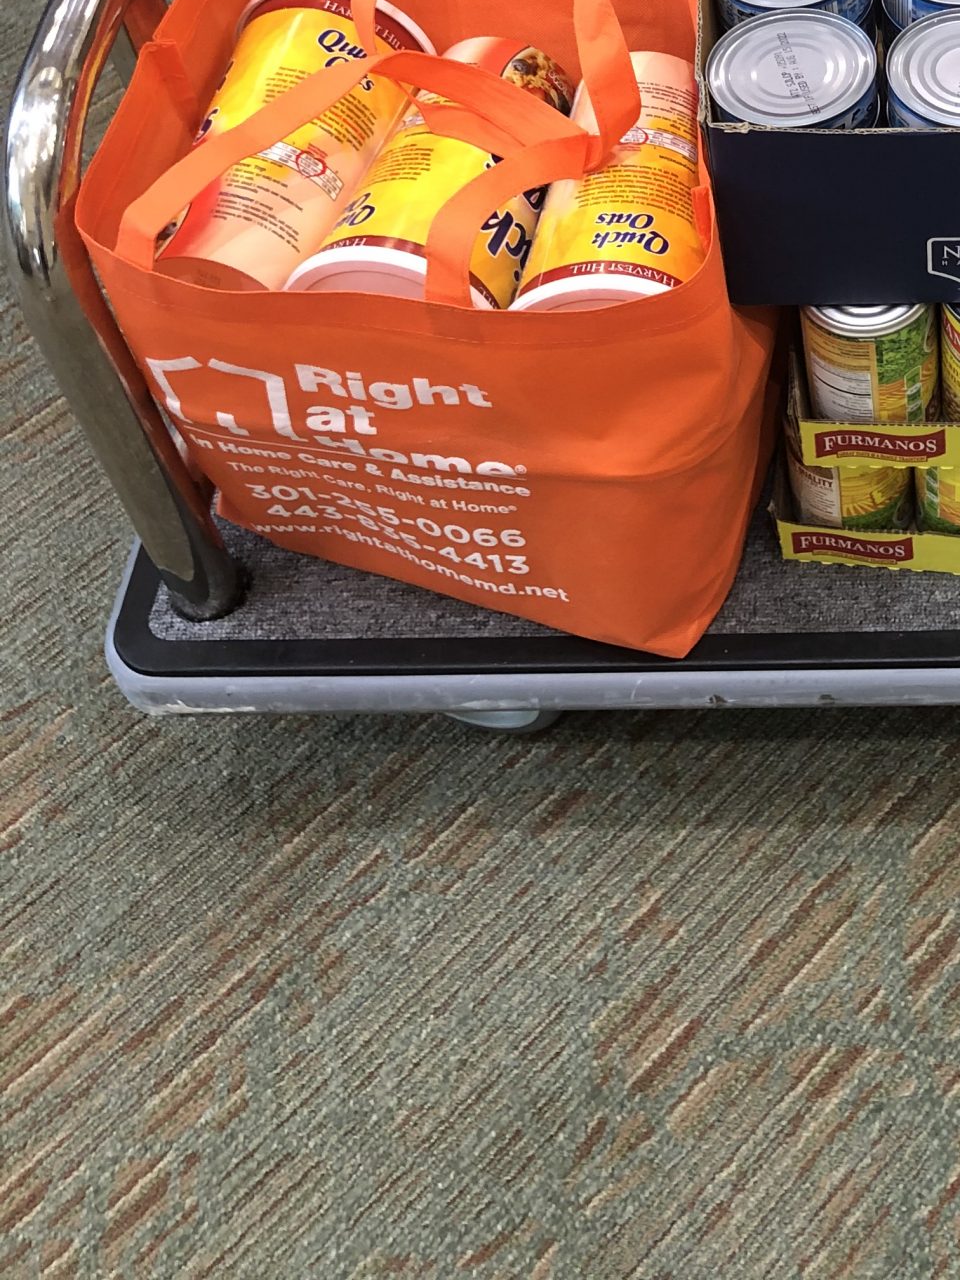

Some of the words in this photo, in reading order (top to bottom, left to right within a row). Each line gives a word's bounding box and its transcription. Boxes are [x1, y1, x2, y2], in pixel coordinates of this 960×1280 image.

[594, 212, 655, 230] Oats
[591, 230, 670, 255] Quick
[570, 262, 606, 275] HILL
[608, 262, 677, 288] HARVEST
[294, 363, 493, 410] Right
[305, 405, 377, 436] at
[823, 434, 938, 453] FURMANOS
[189, 433, 214, 450] In
[217, 441, 292, 460] Home
[297, 453, 357, 472] Care
[365, 462, 384, 477] &
[391, 468, 531, 497] Assistance
[226, 461, 265, 474] The
[268, 465, 321, 480] Right
[323, 473, 372, 494] Care,
[374, 483, 425, 506] Right
[429, 495, 448, 511] at
[245, 483, 527, 548] 301-255-0066
[799, 535, 906, 558] FURMANOS
[250, 522, 570, 602] www.rightathomemd.net
